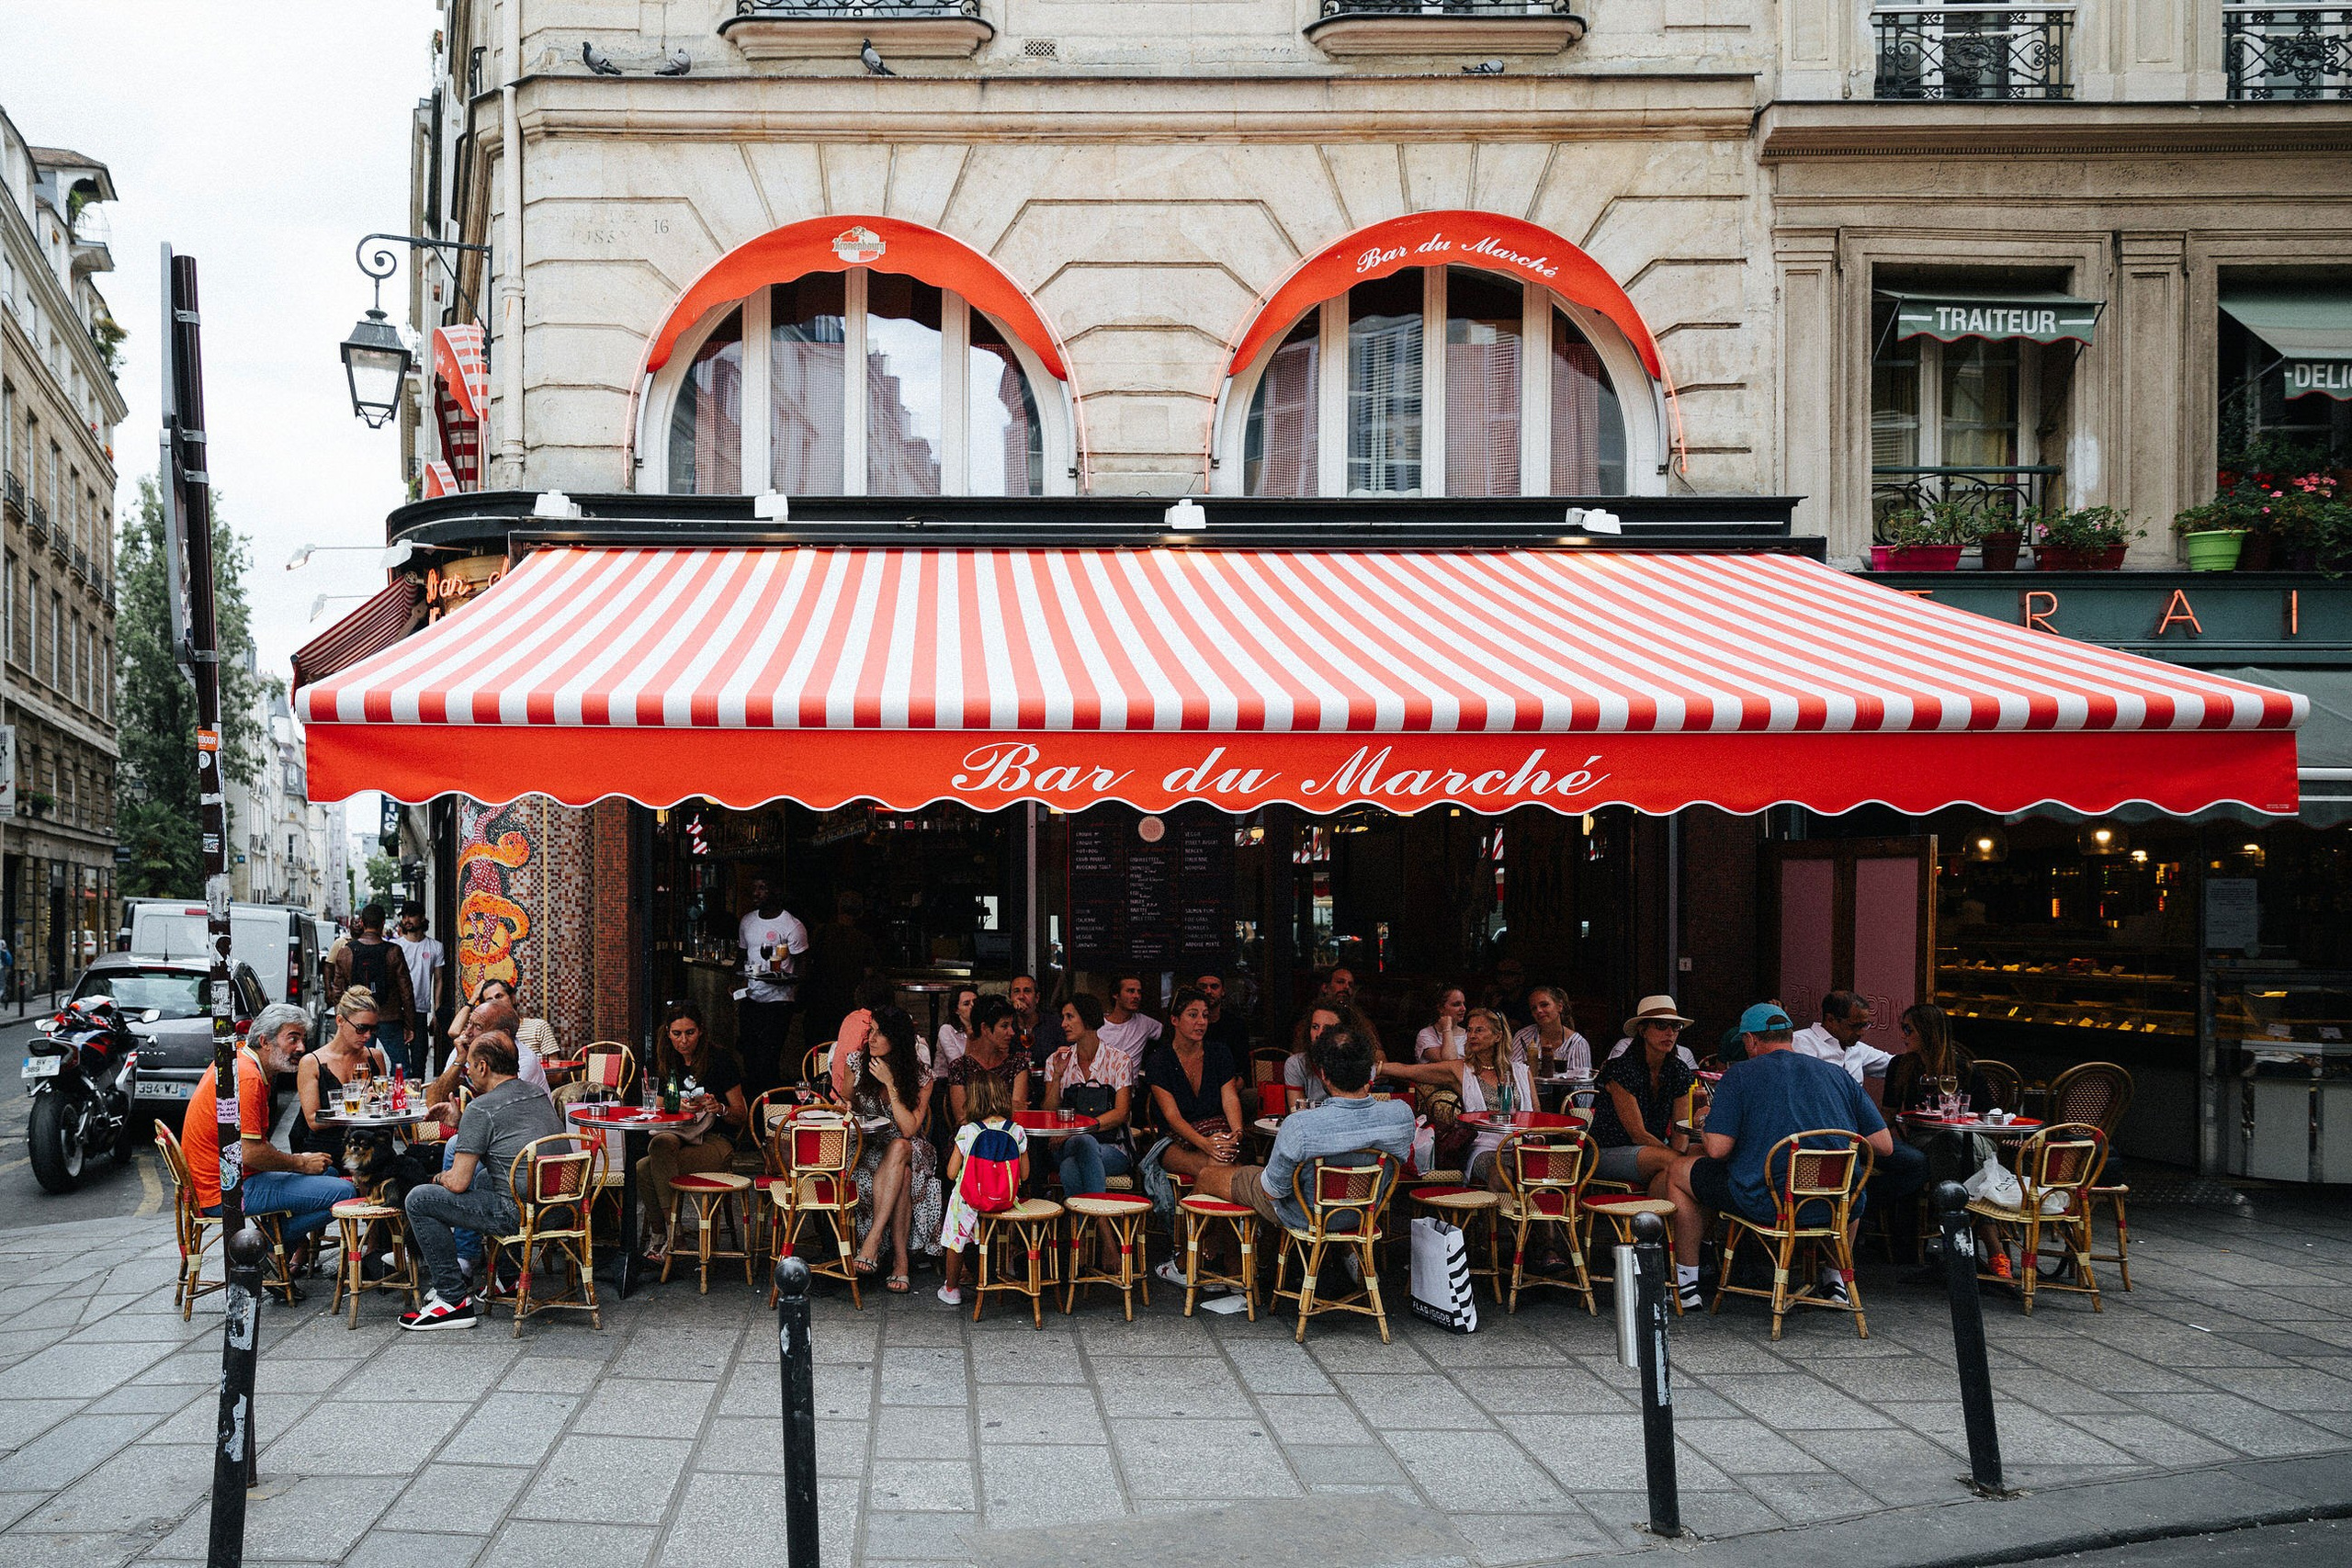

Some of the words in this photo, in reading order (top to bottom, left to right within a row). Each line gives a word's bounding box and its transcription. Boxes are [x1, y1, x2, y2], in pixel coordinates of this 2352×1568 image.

[653, 219, 670, 234] 16
[831, 237, 887, 255] Kronenbourg
[1356, 246, 1408, 274] Bar
[1415, 232, 1452, 254] du
[1461, 236, 1559, 278] Marché
[1935, 306, 2057, 334] TRAITEUR
[2294, 364, 2352, 389] DELI
[426, 568, 472, 604] Bar
[952, 741, 1135, 792] Bar
[1162, 747, 1283, 794] du
[1301, 745, 1611, 796] Marché
